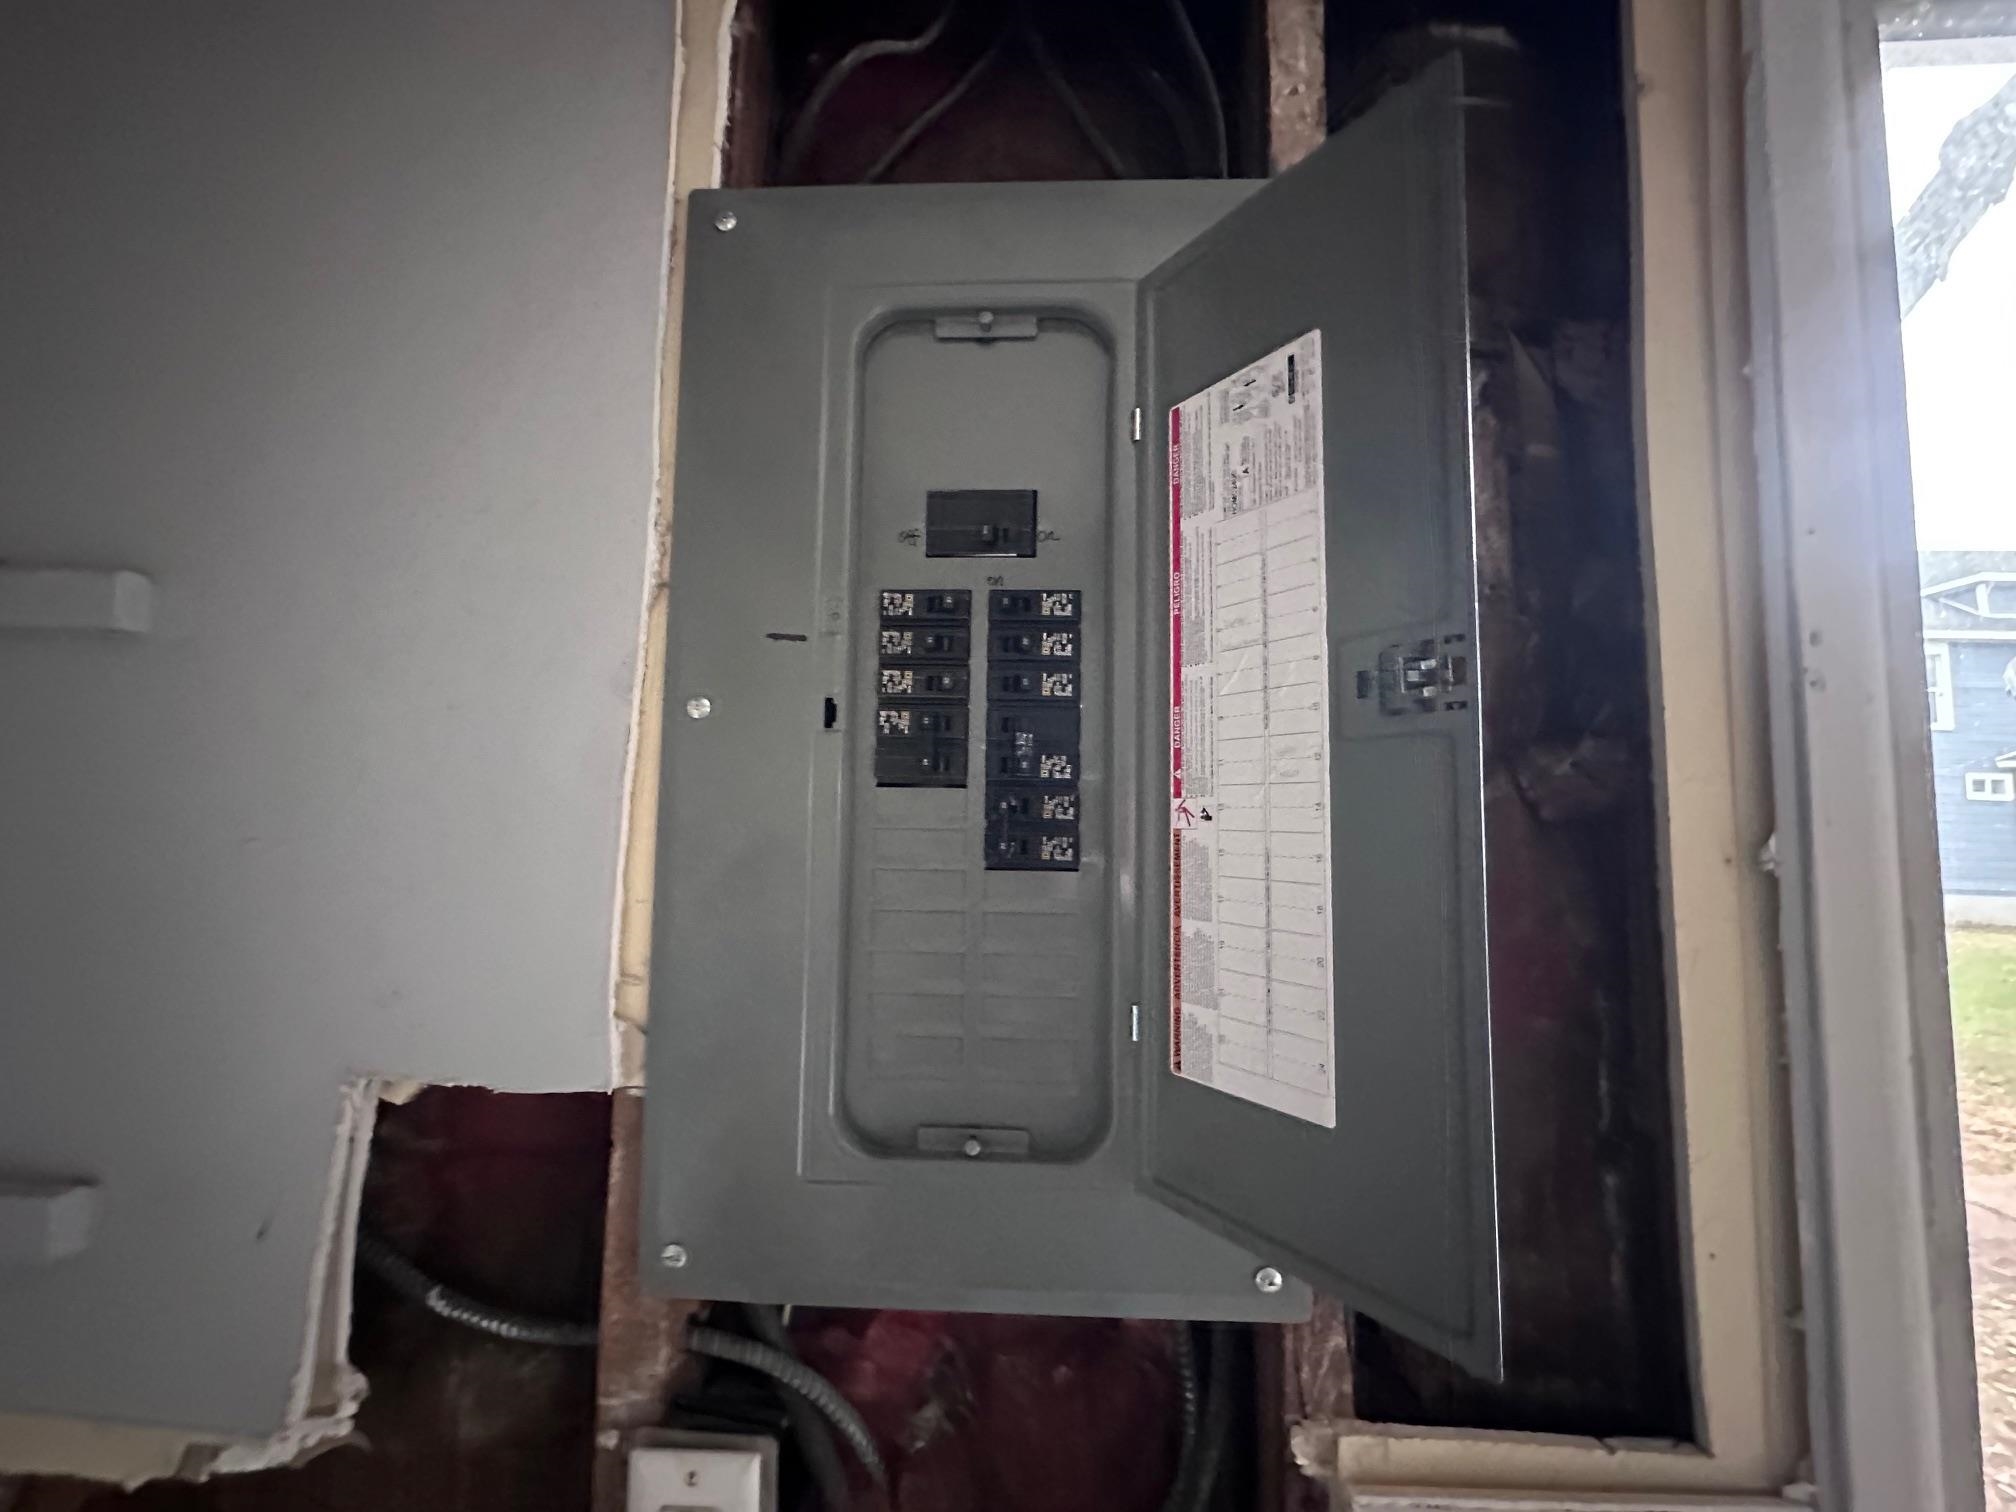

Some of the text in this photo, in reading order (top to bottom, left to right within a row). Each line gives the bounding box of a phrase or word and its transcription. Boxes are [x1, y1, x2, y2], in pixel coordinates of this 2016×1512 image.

[1174, 832, 1182, 1056] WARNING ADVERTENCIA AVERTISSEMENT
